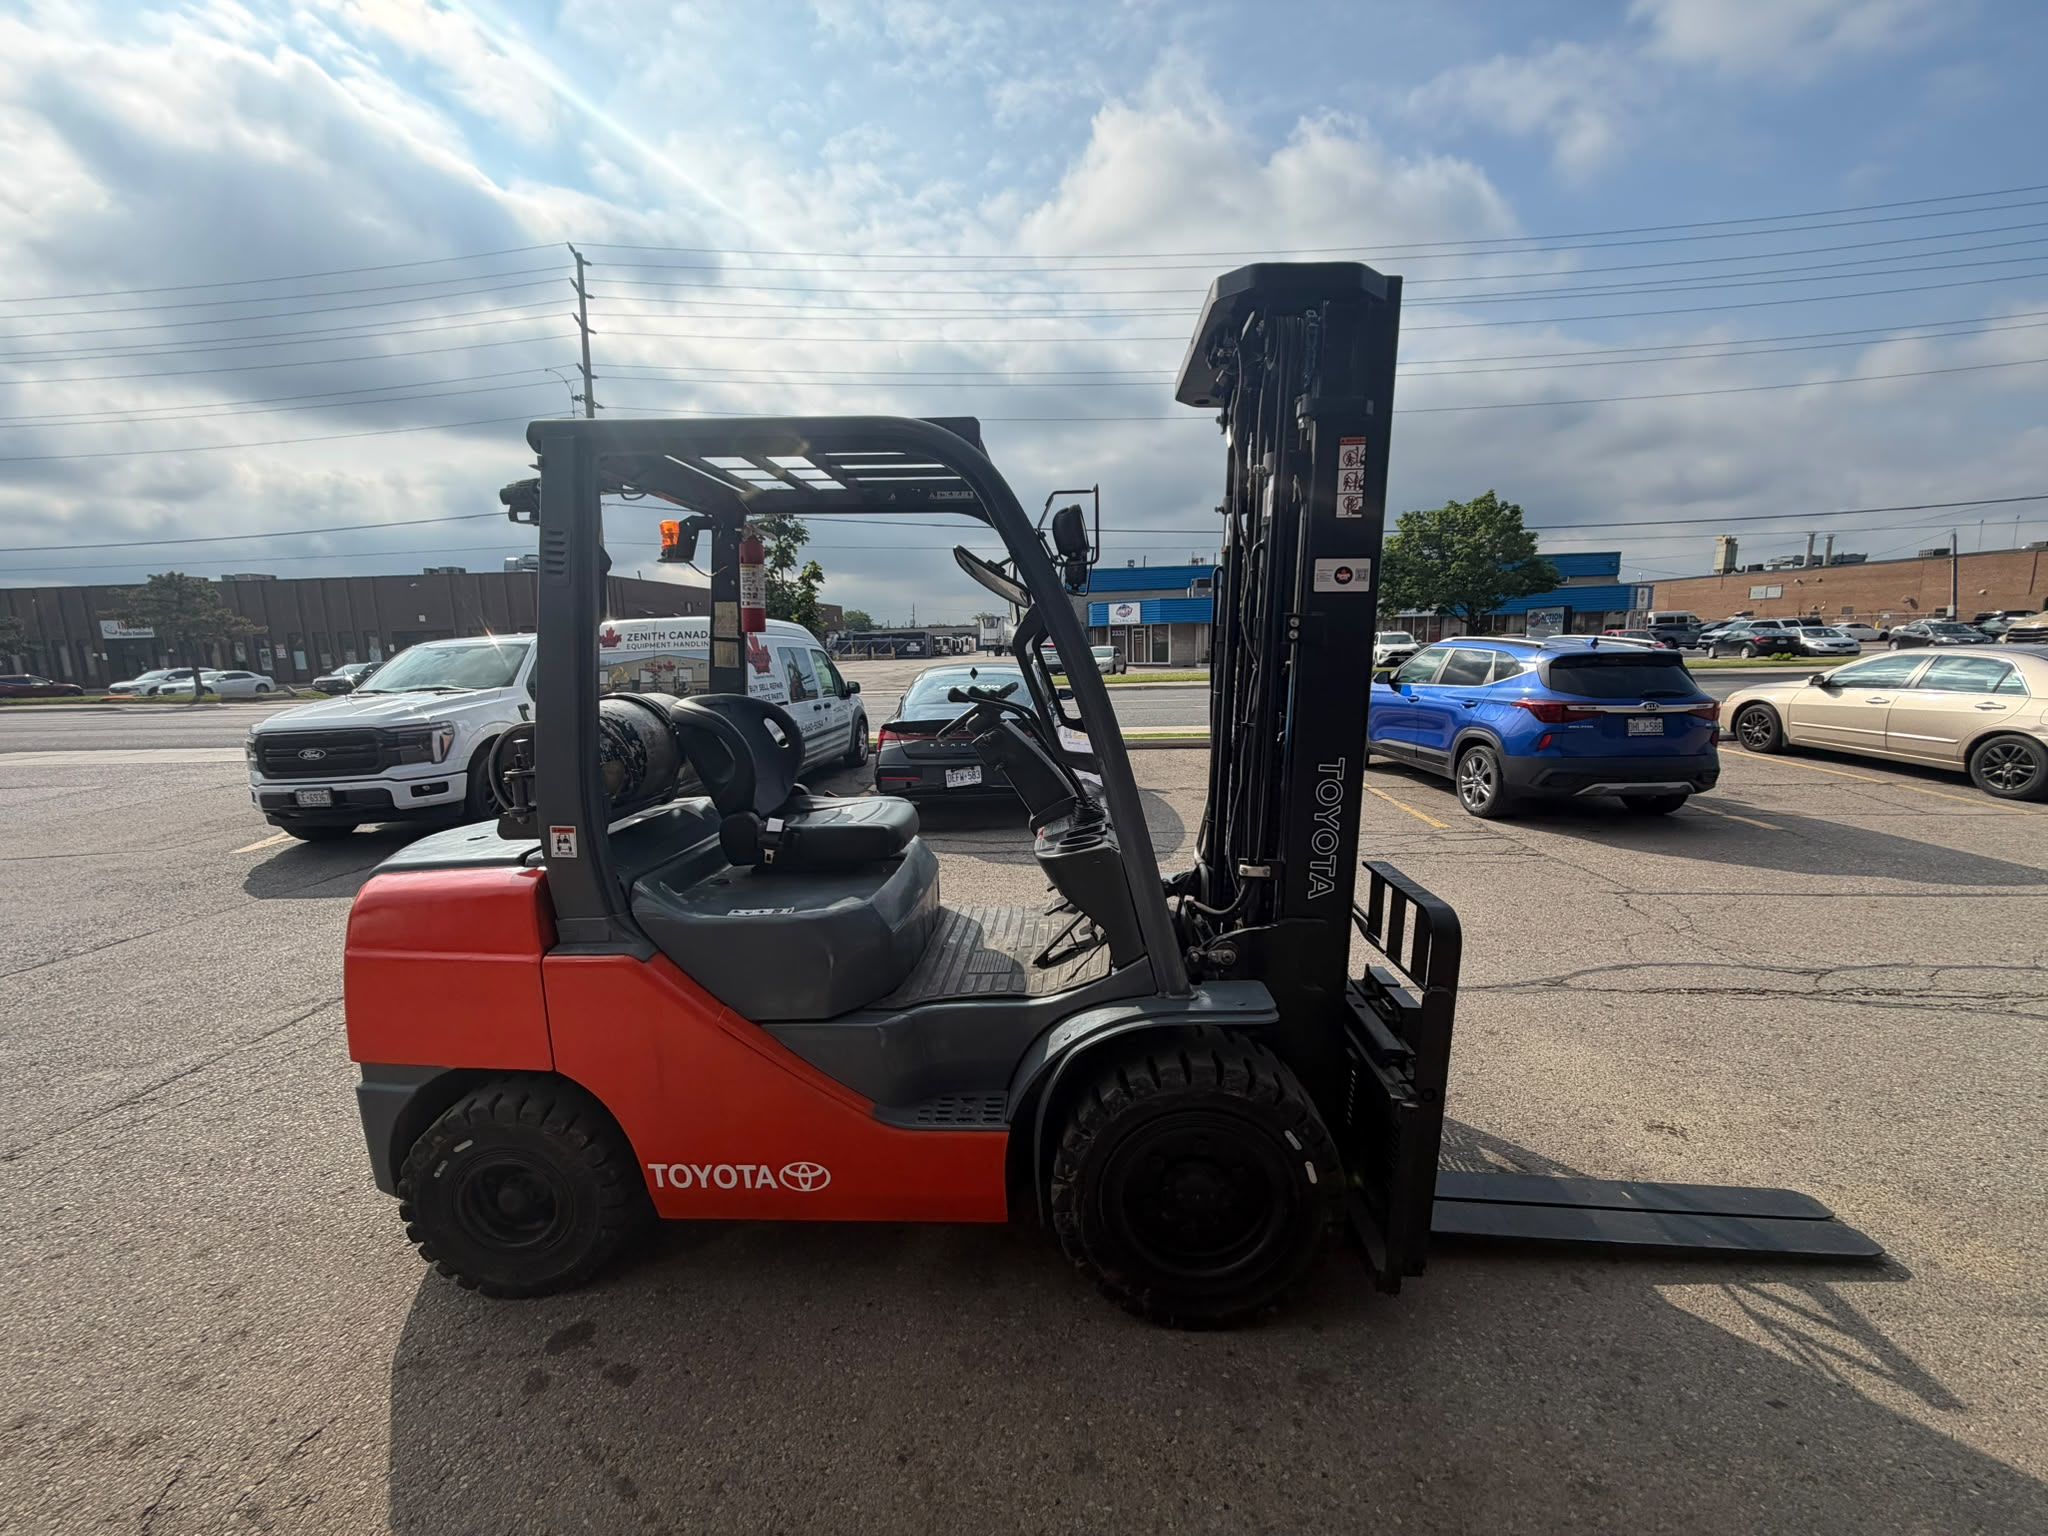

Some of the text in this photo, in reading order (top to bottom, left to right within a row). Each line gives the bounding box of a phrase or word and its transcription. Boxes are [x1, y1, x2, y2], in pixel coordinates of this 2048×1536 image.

[1541, 612, 1563, 620] ACTION
[627, 631, 666, 642] ZENITH
[626, 641, 671, 650] EQUIPMENT
[1307, 757, 1346, 900] TOYOTA
[647, 1163, 779, 1190] TOYOTA
